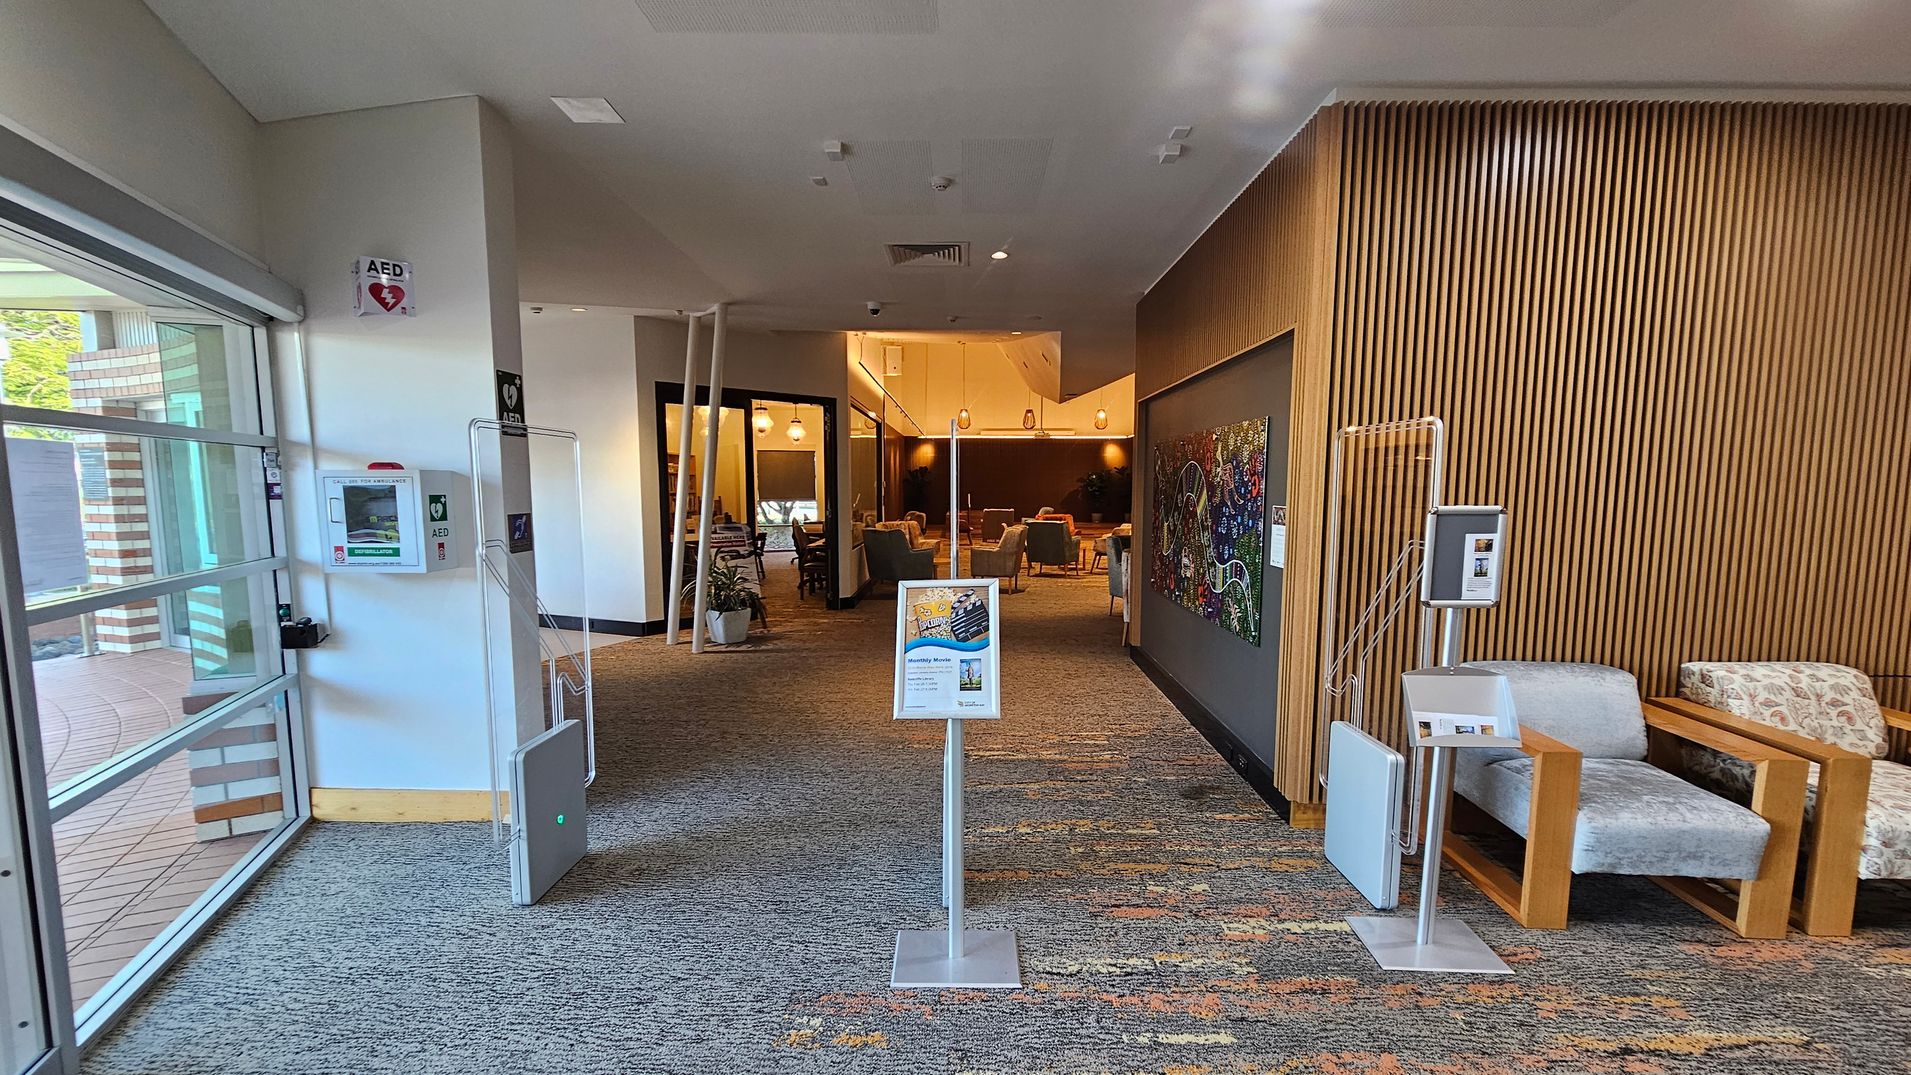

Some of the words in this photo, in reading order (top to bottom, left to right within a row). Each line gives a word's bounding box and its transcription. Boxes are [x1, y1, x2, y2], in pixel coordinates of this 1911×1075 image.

[367, 260, 403, 277] AED
[502, 412, 521, 424] AED
[432, 528, 449, 538] AED
